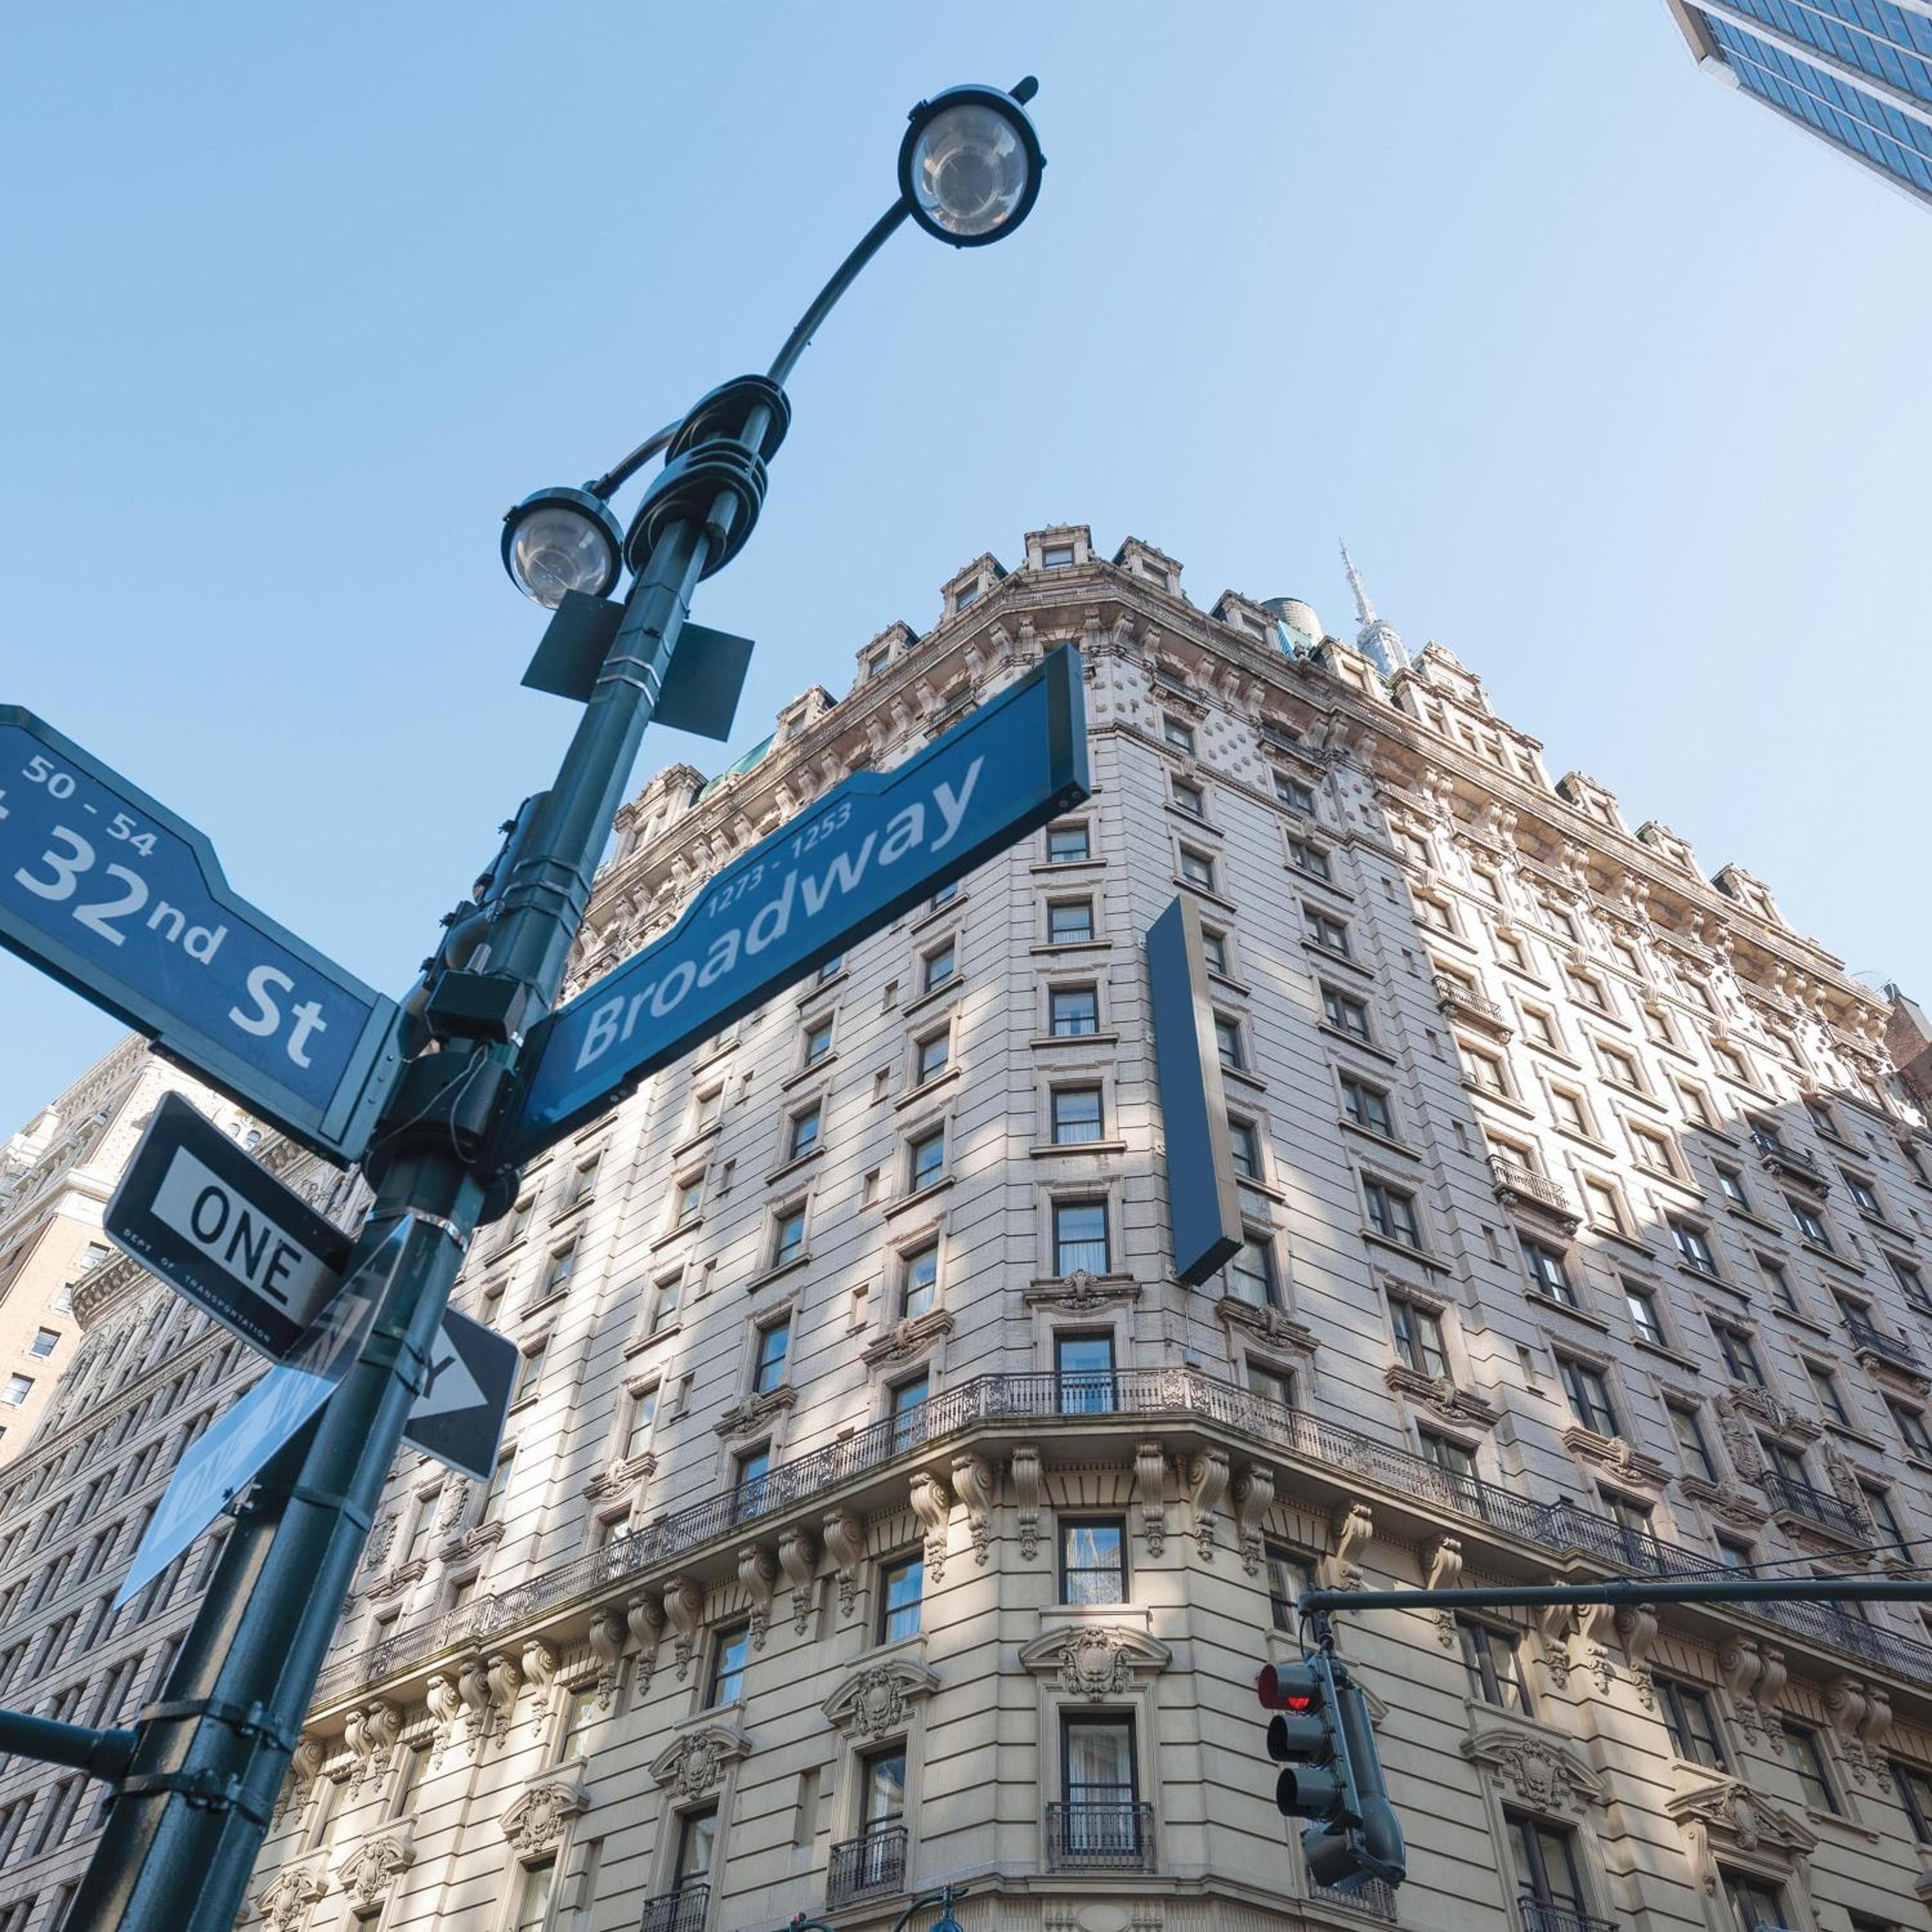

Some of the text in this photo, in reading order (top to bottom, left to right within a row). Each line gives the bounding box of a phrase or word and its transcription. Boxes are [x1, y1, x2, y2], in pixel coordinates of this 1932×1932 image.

[21, 755, 75, 799] 50
[106, 813, 158, 857] 54
[708, 865, 764, 918] 1273
[791, 802, 851, 859] 1253
[14, 824, 328, 1070] 32nd St
[575, 756, 984, 1072] Broadway
[123, 1228, 271, 1343] DEPT OF TRANSPORTATION
[191, 1185, 303, 1306] ONE
